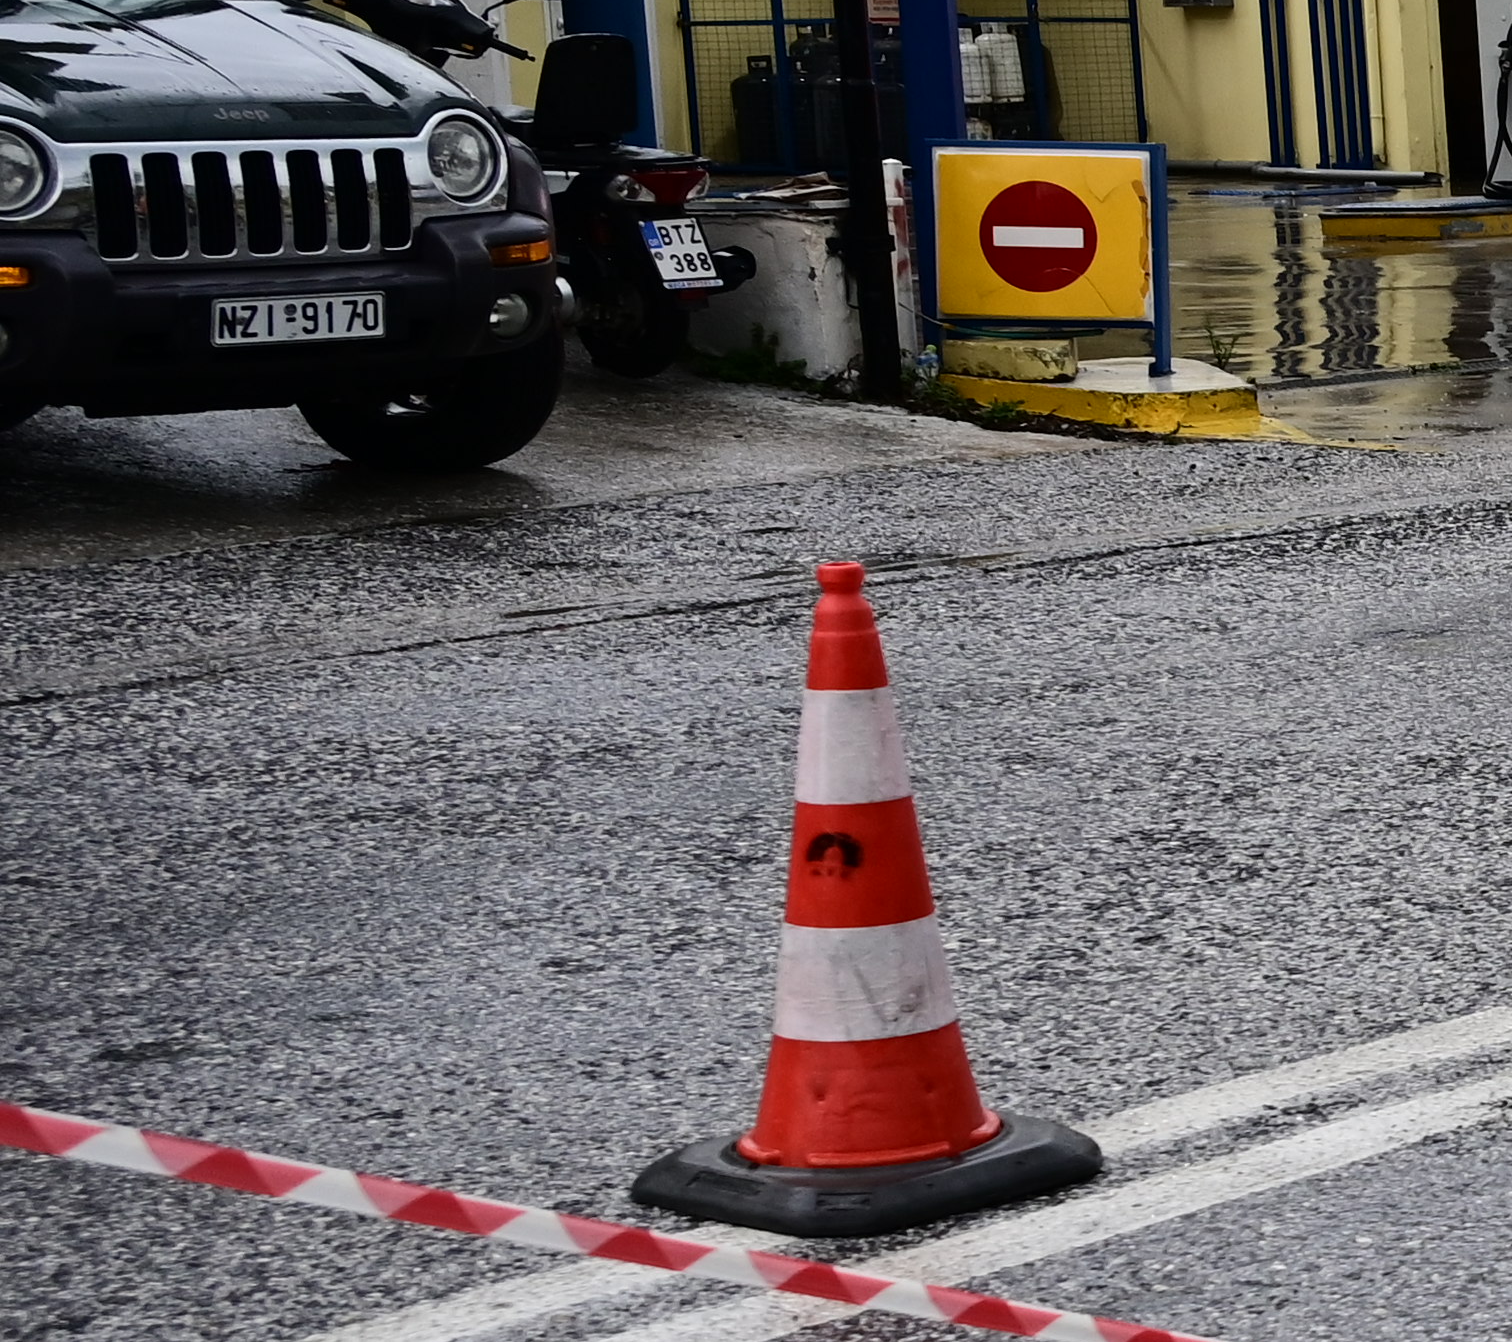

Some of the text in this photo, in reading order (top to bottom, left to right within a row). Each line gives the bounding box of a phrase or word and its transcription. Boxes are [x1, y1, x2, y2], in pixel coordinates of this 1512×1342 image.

[214, 108, 270, 123] Jeep
[657, 224, 702, 246] BTZ
[670, 252, 711, 273] 388
